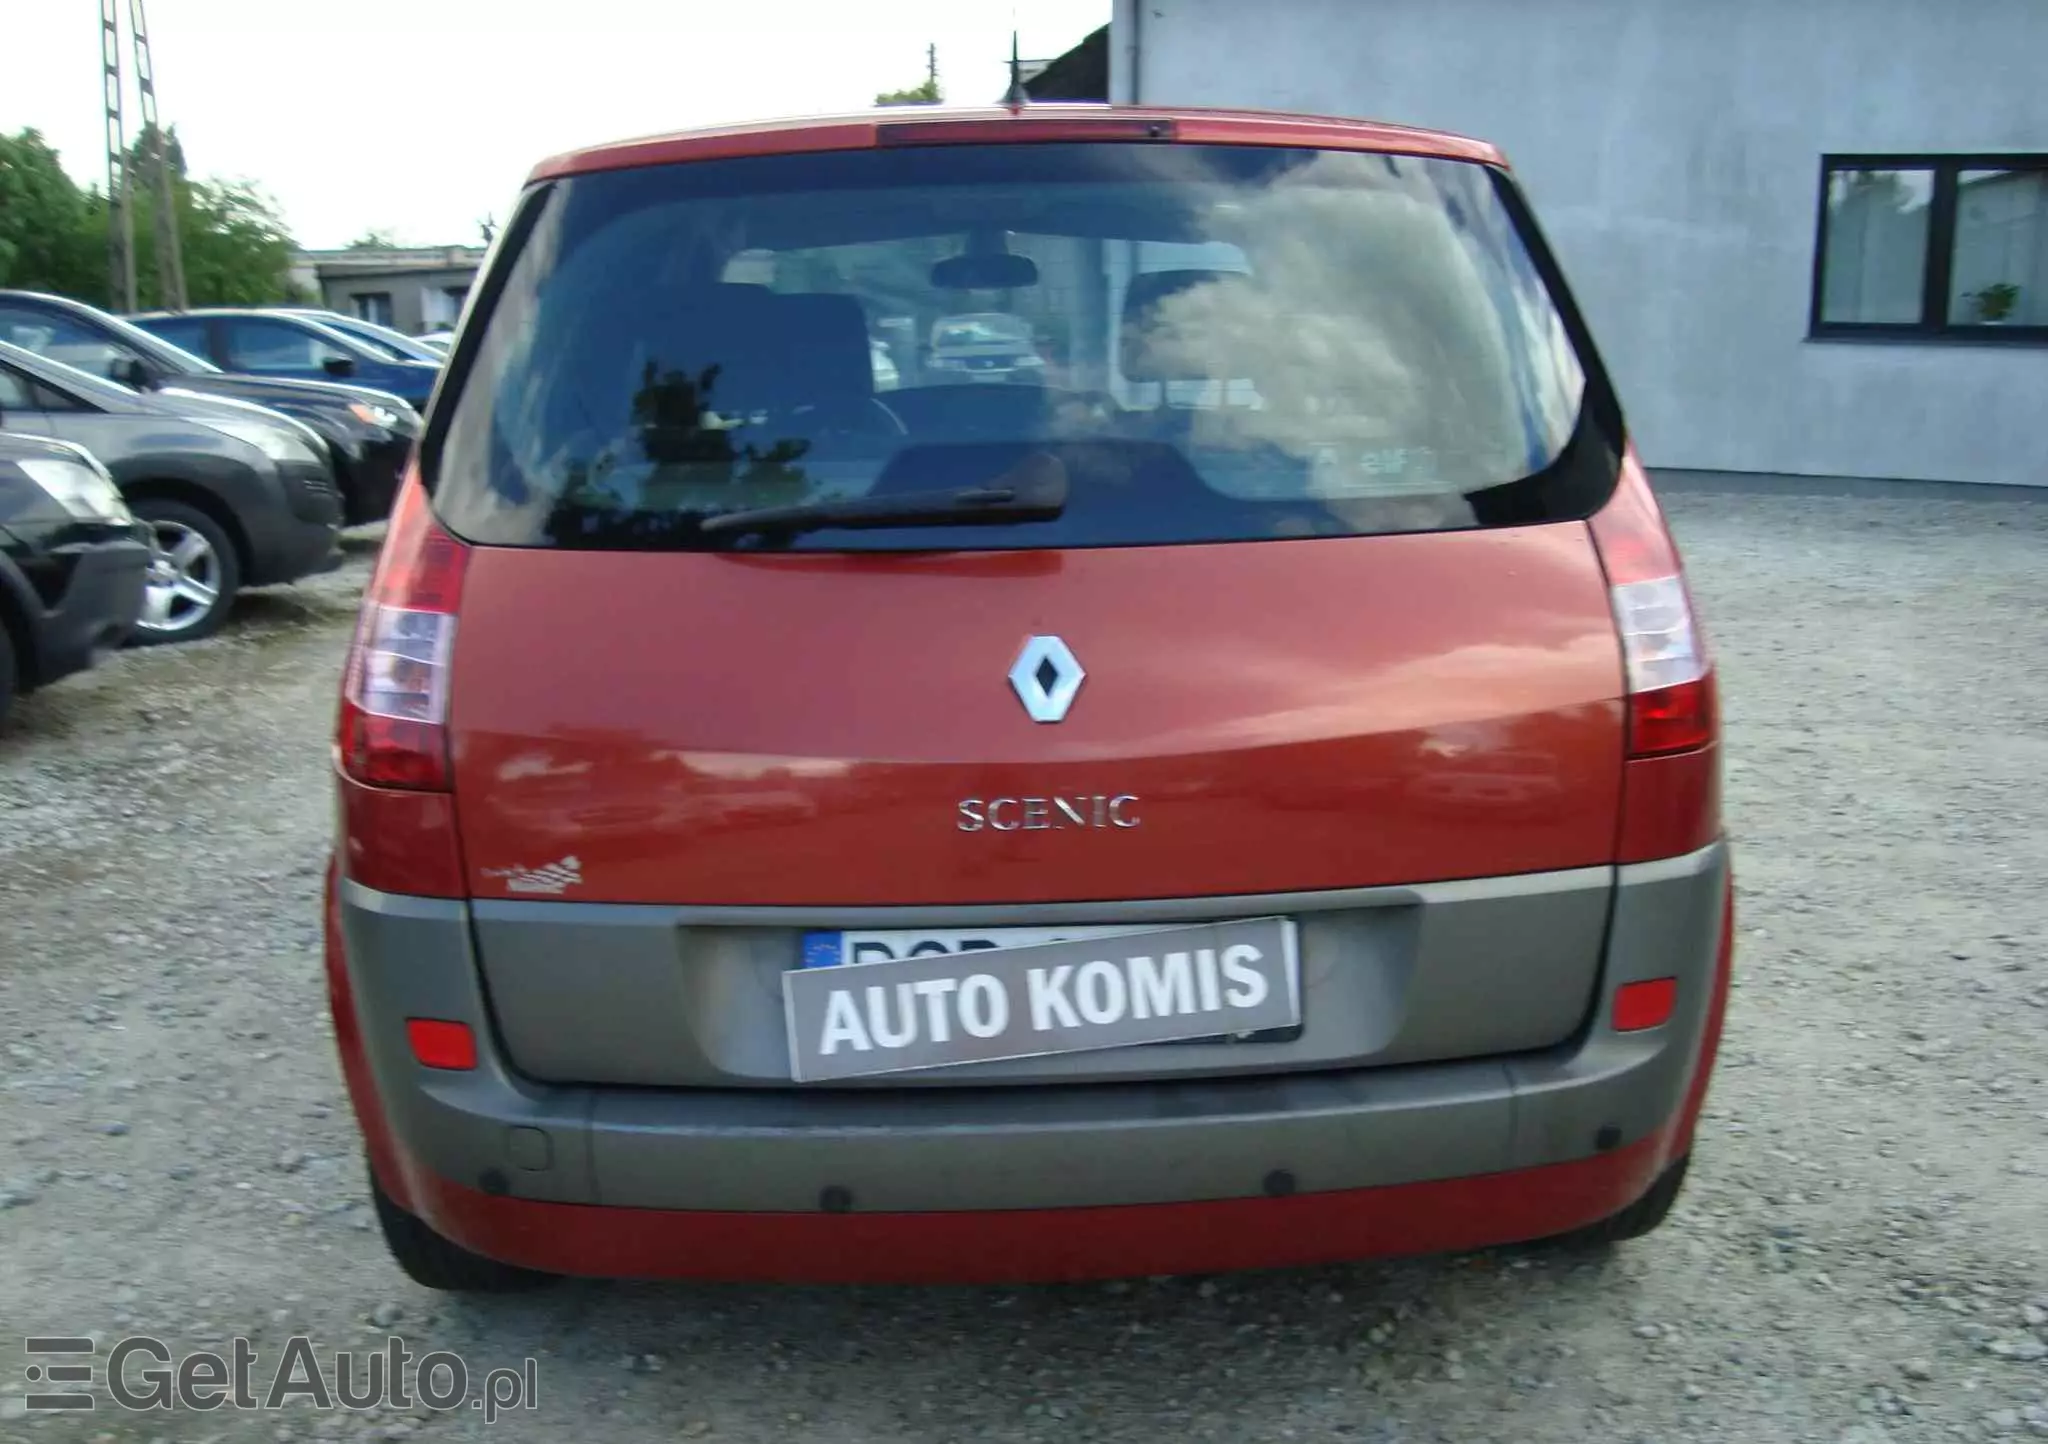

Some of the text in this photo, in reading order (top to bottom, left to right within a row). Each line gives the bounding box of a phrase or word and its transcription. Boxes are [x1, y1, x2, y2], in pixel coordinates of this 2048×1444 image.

[957, 795, 1141, 832] SCENIC
[819, 944, 1269, 1055] AUTO KOMIS
